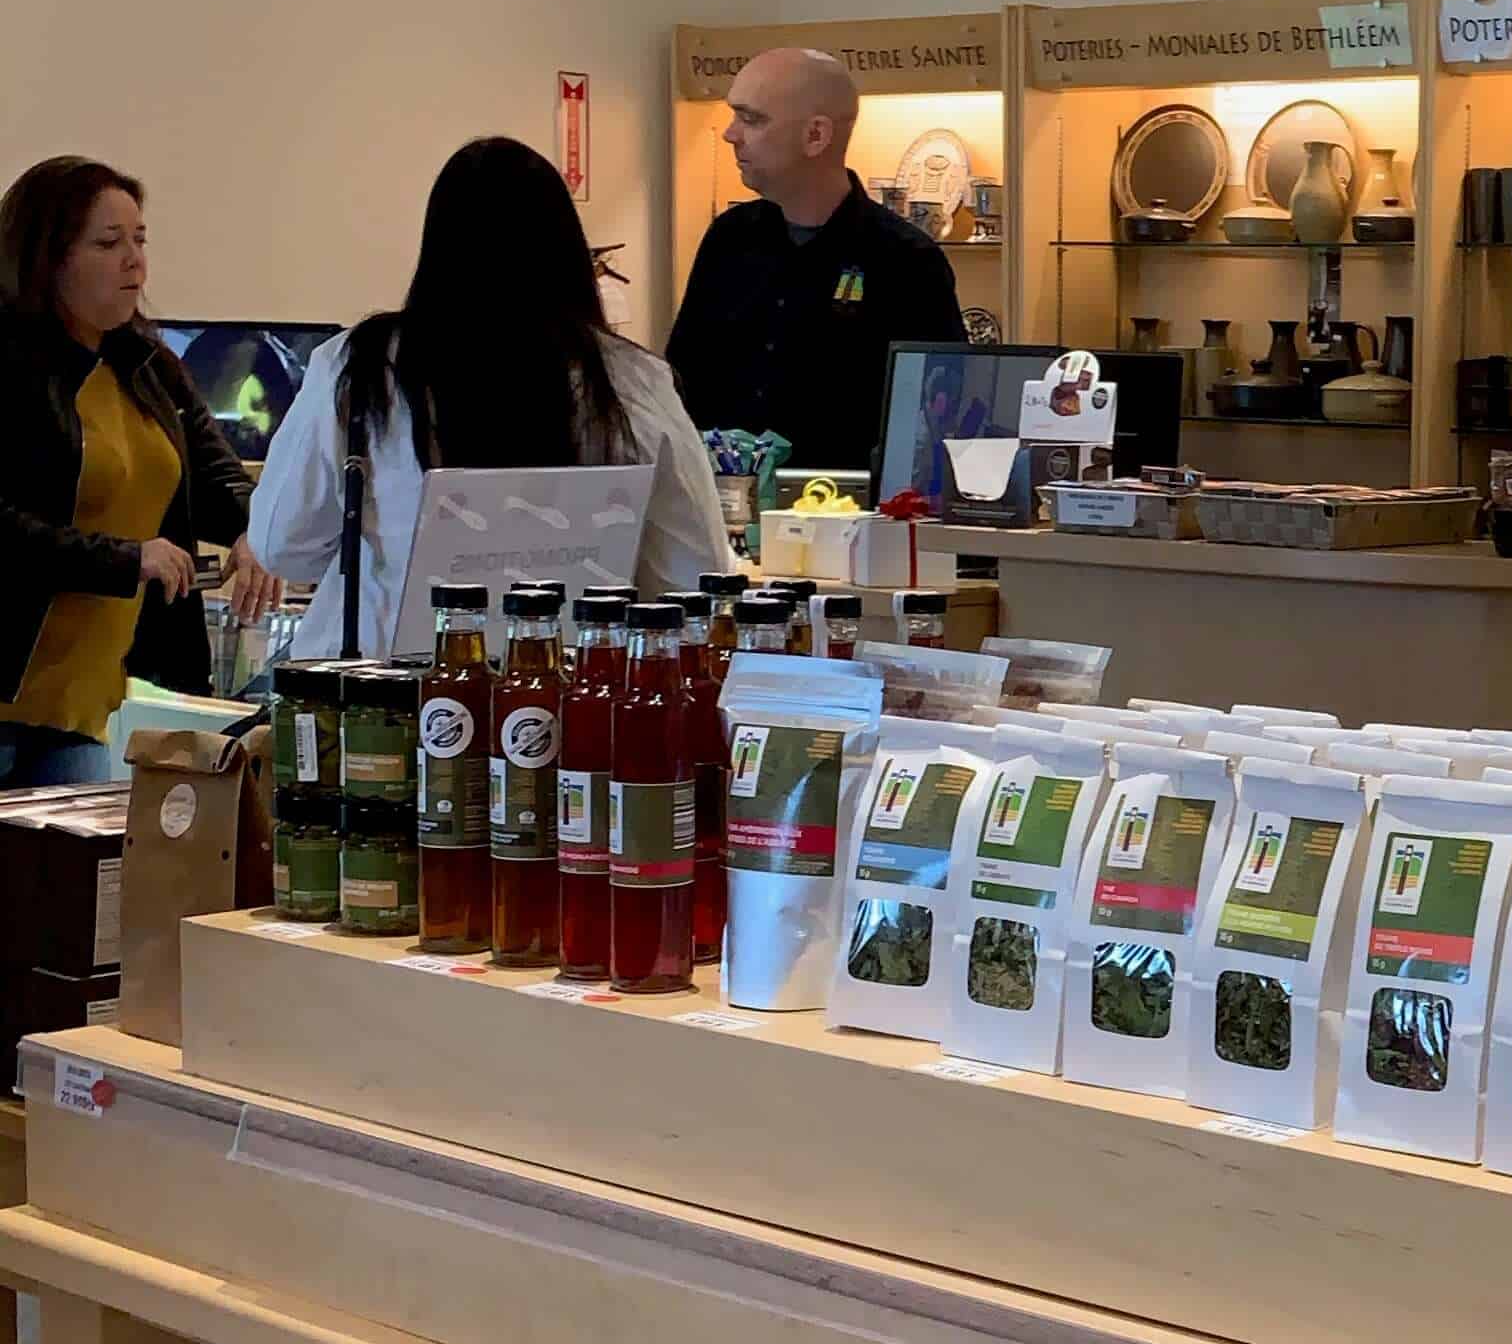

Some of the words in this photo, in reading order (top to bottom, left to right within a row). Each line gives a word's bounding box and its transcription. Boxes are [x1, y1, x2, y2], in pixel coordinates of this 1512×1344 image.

[1041, 38, 1124, 62] POTERIES
[1147, 31, 1250, 58] MONIALES
[1258, 30, 1283, 53] DE
[1290, 17, 1401, 51] BETHLÉEM
[691, 55, 750, 77] PORCE
[840, 48, 905, 72] TERRE
[910, 44, 986, 69] SAINTE
